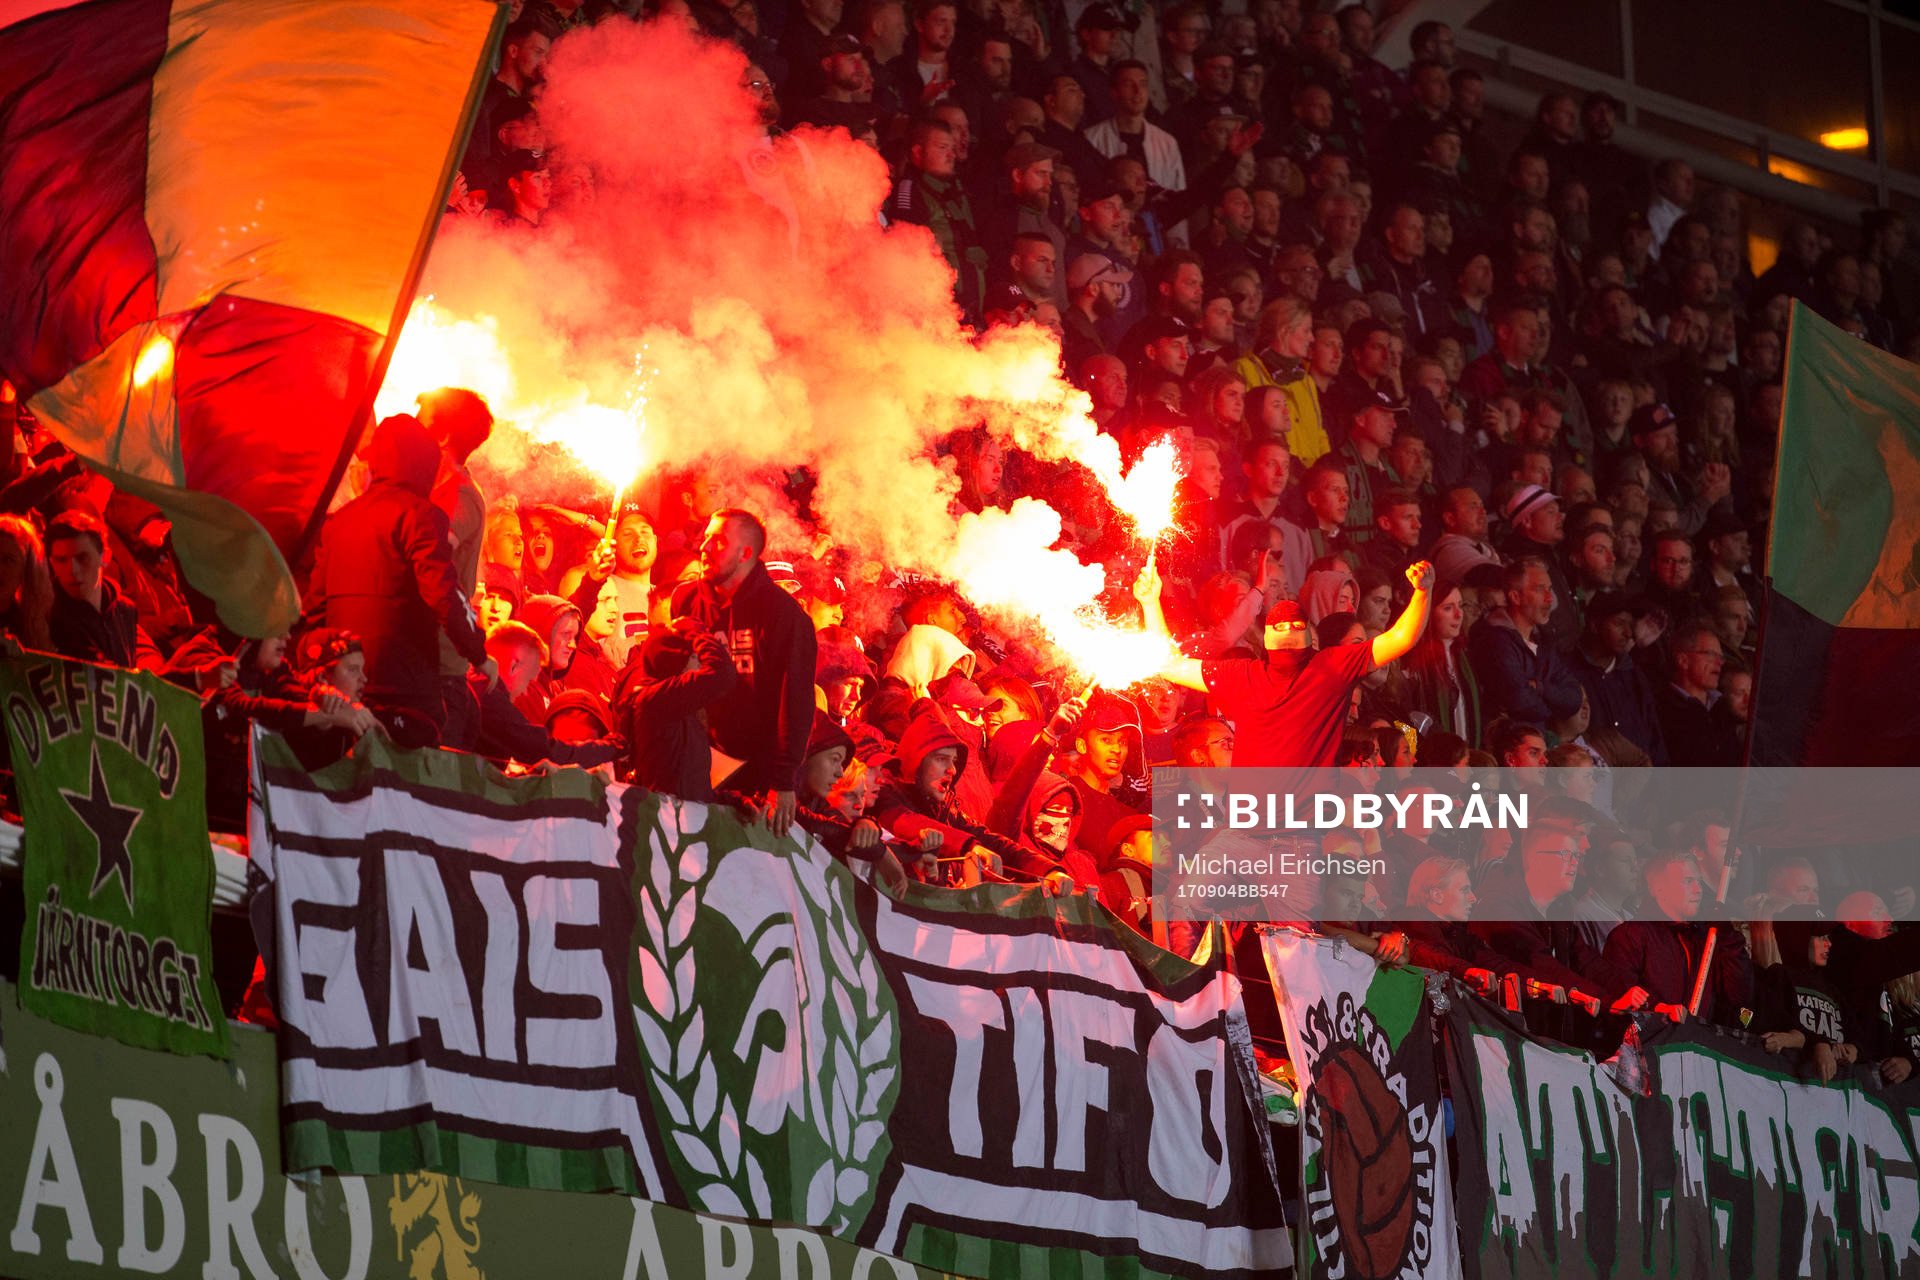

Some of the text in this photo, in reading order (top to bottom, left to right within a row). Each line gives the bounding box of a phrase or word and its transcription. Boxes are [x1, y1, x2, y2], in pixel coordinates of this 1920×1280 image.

[7, 660, 180, 800] DEFEND
[273, 841, 618, 1067] GAIS
[10, 1051, 373, 1280] ÅBRO
[902, 972, 1231, 1209] TIFO
